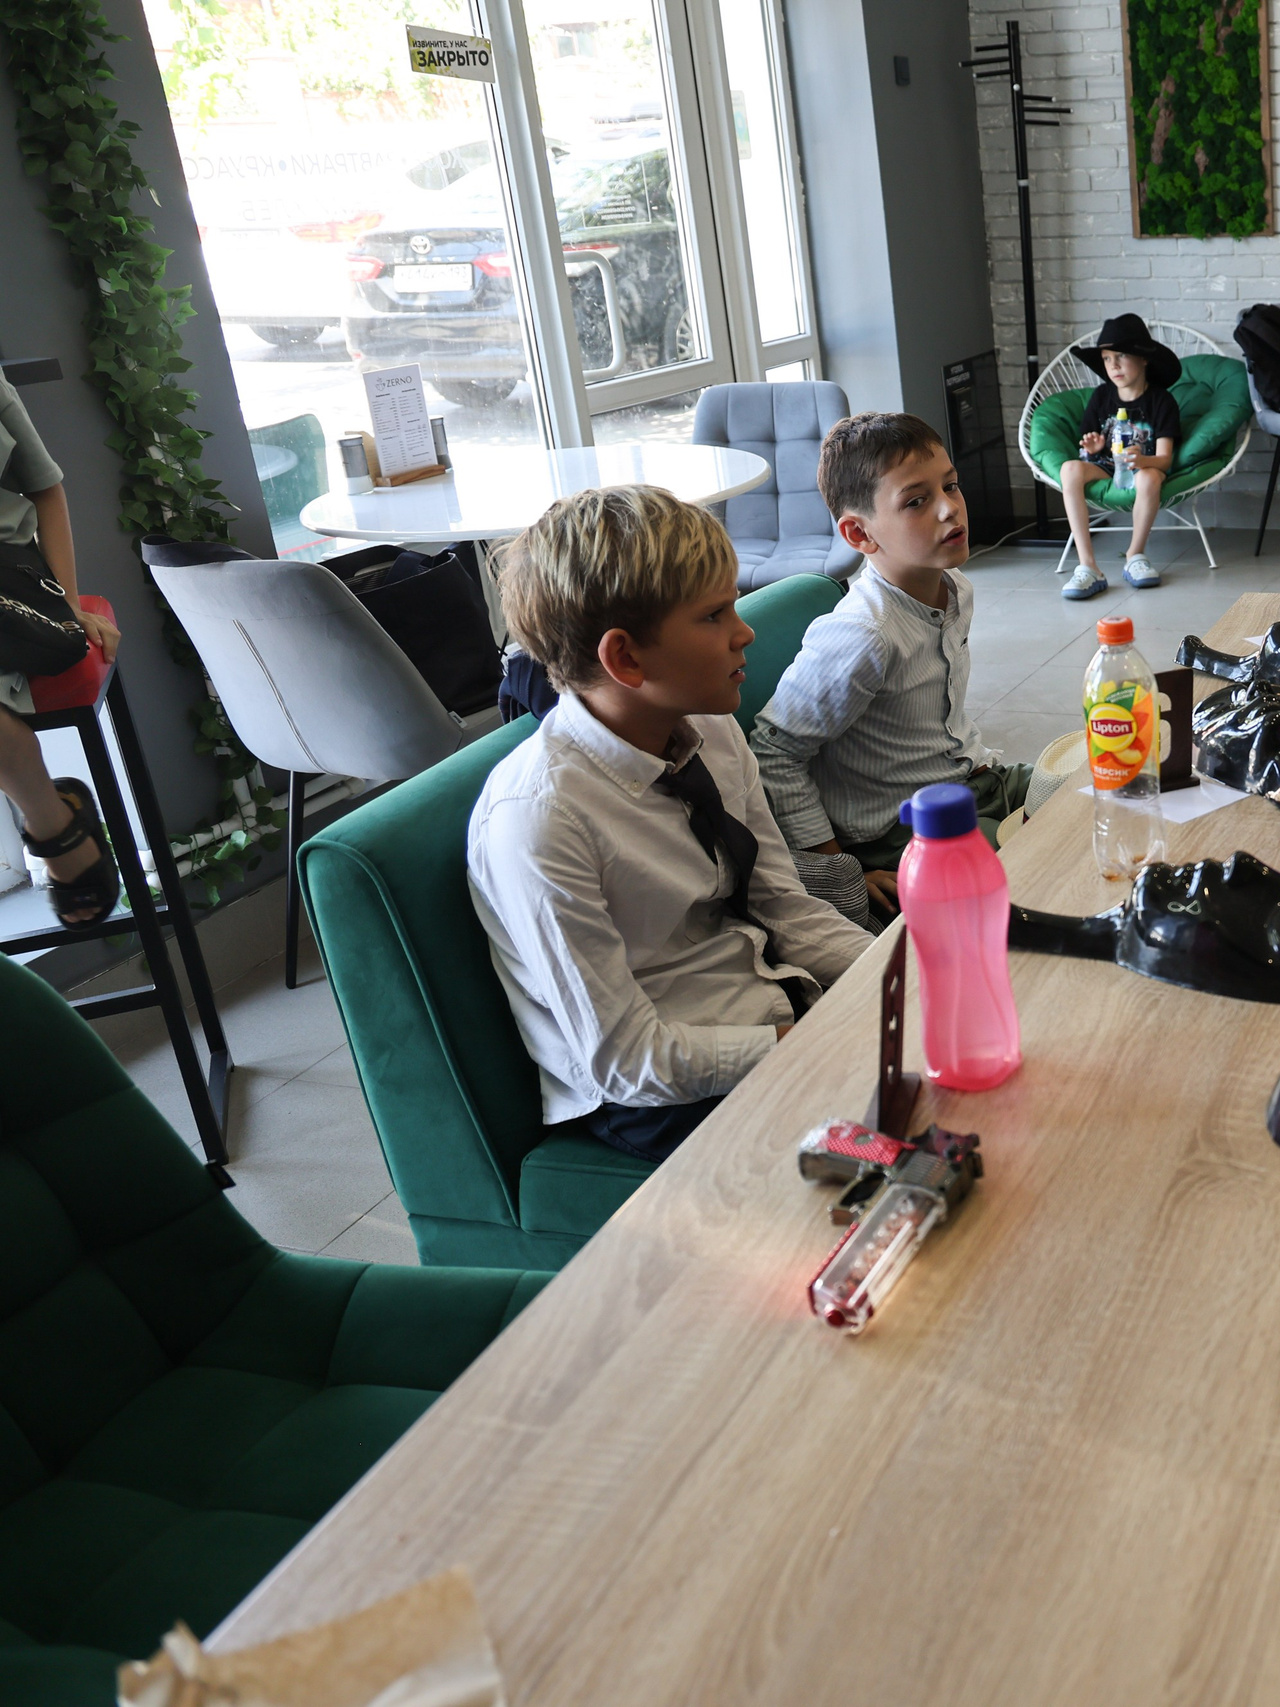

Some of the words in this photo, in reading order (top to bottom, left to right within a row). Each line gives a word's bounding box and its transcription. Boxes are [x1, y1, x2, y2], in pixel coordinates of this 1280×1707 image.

[412, 40, 449, 49] ИЗВИНИТЕ,
[449, 40, 455, 48] У
[455, 40, 468, 48] НАС
[417, 50, 489, 67] ЗАКРЫТО
[386, 376, 413, 388] ZERNO
[1091, 720, 1130, 734] Lipton
[1093, 765, 1129, 777] ПЕРСИК
